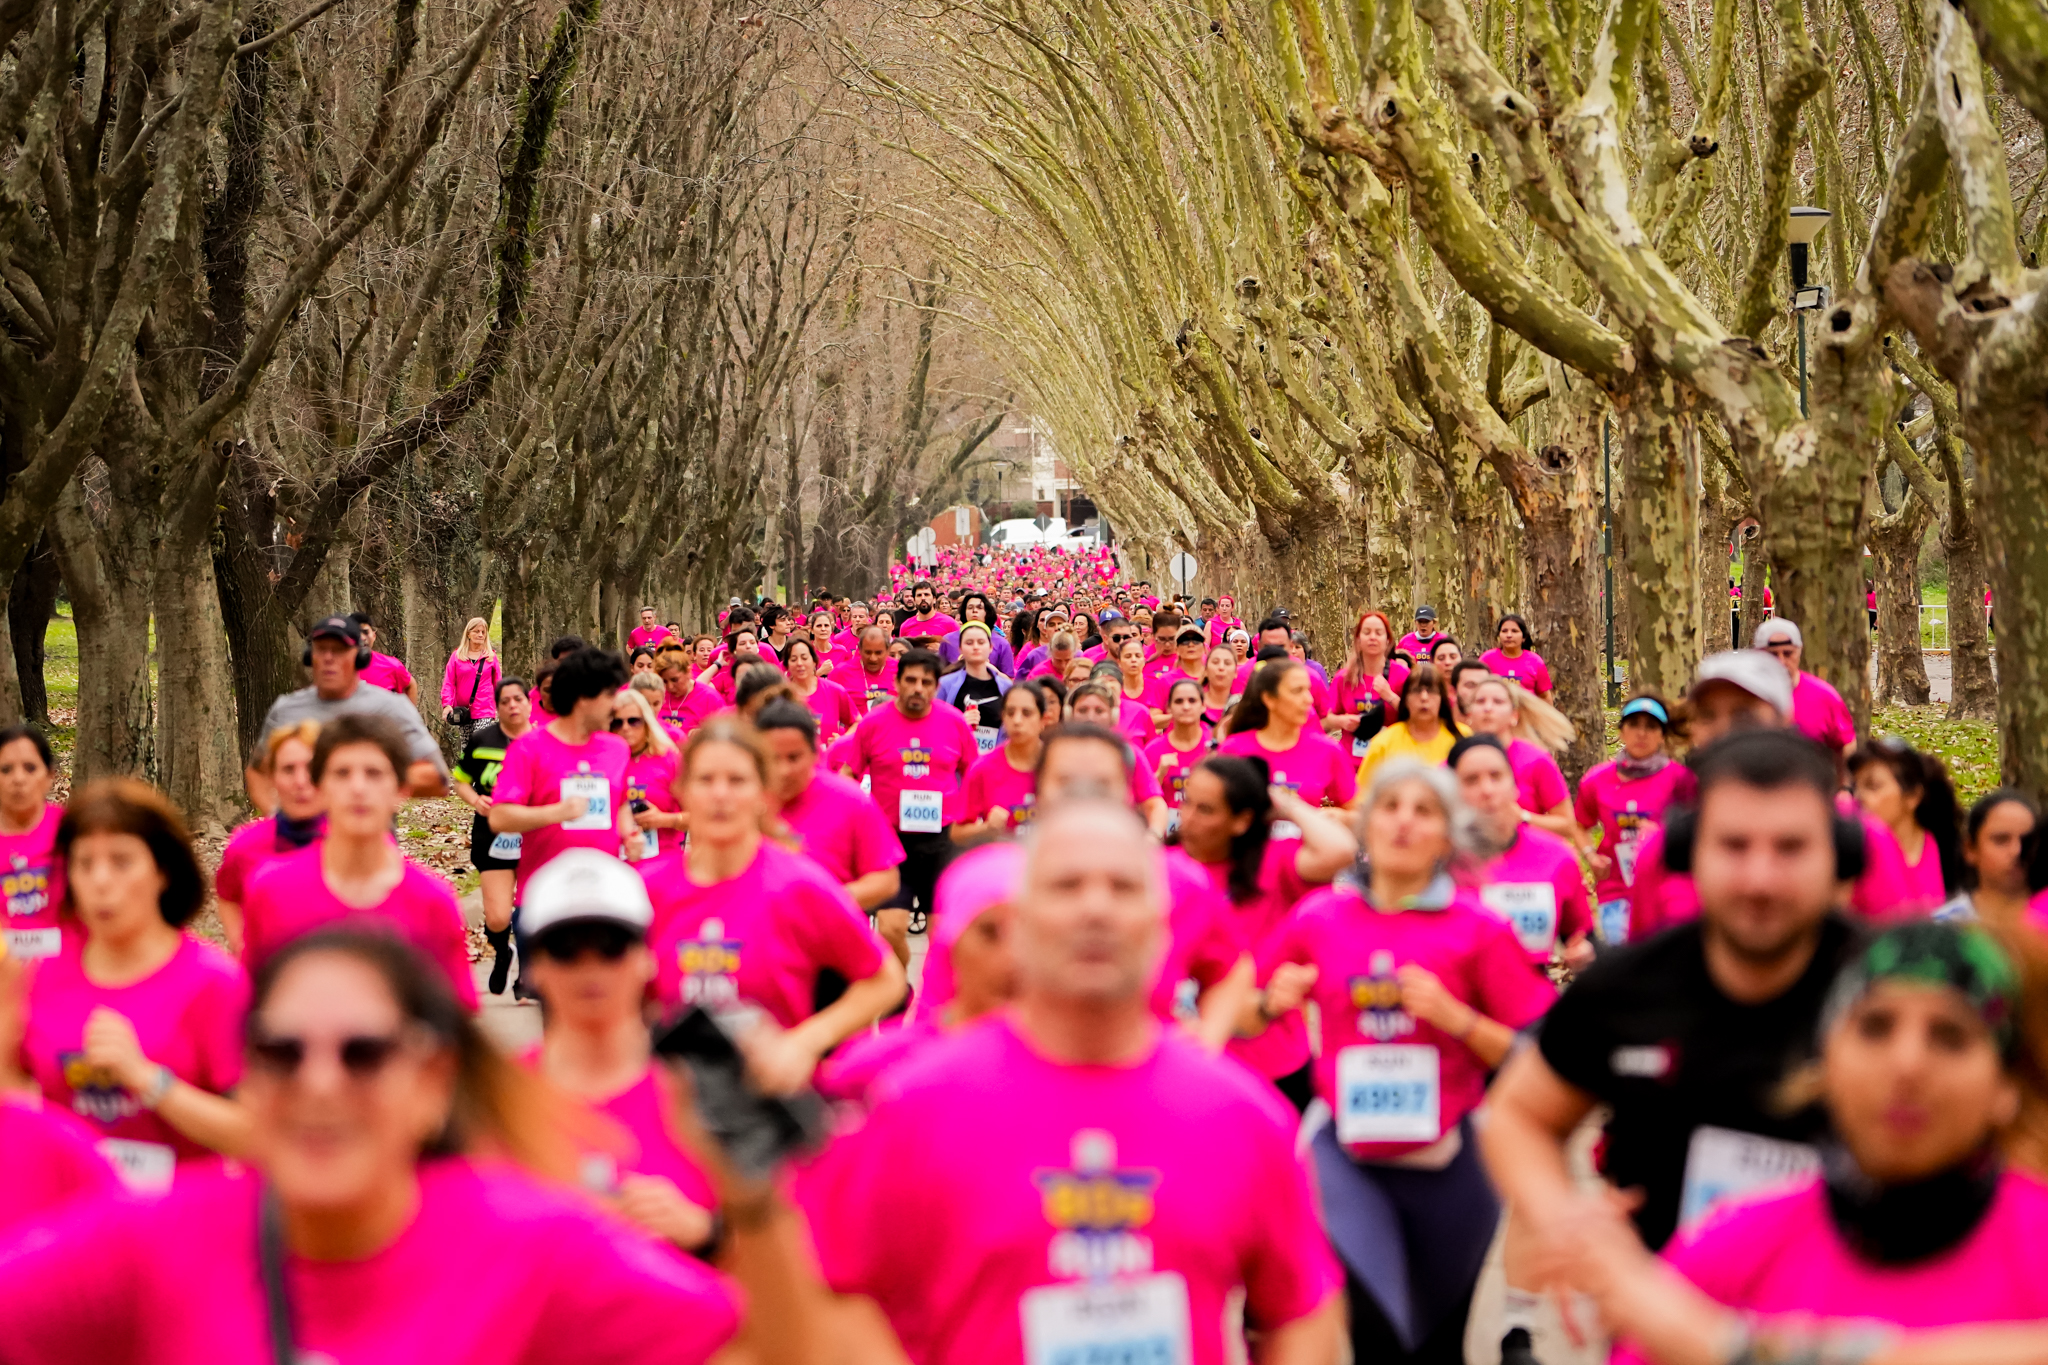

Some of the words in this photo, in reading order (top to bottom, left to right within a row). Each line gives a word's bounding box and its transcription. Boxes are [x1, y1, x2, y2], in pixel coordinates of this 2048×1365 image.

[901, 749, 931, 763] 80s
[903, 764, 930, 780] RUN
[913, 793, 932, 802] RUN
[904, 806, 939, 821] 4006
